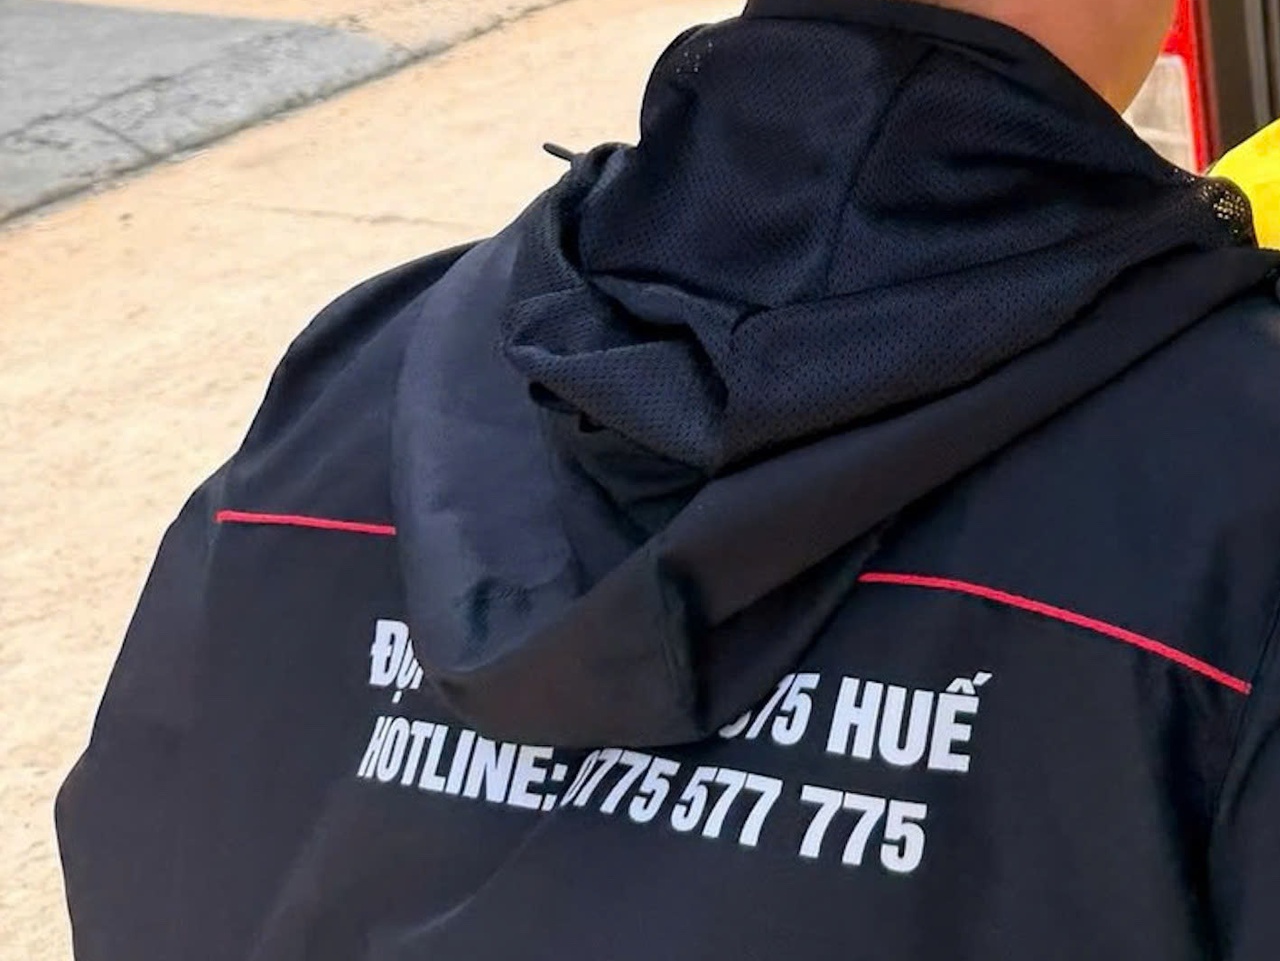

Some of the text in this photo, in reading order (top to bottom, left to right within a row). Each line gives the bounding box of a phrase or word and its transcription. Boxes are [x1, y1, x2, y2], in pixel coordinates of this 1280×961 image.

[826, 671, 993, 773] HUẾ
[357, 715, 928, 874] HOTLINE: 0775 577 775
